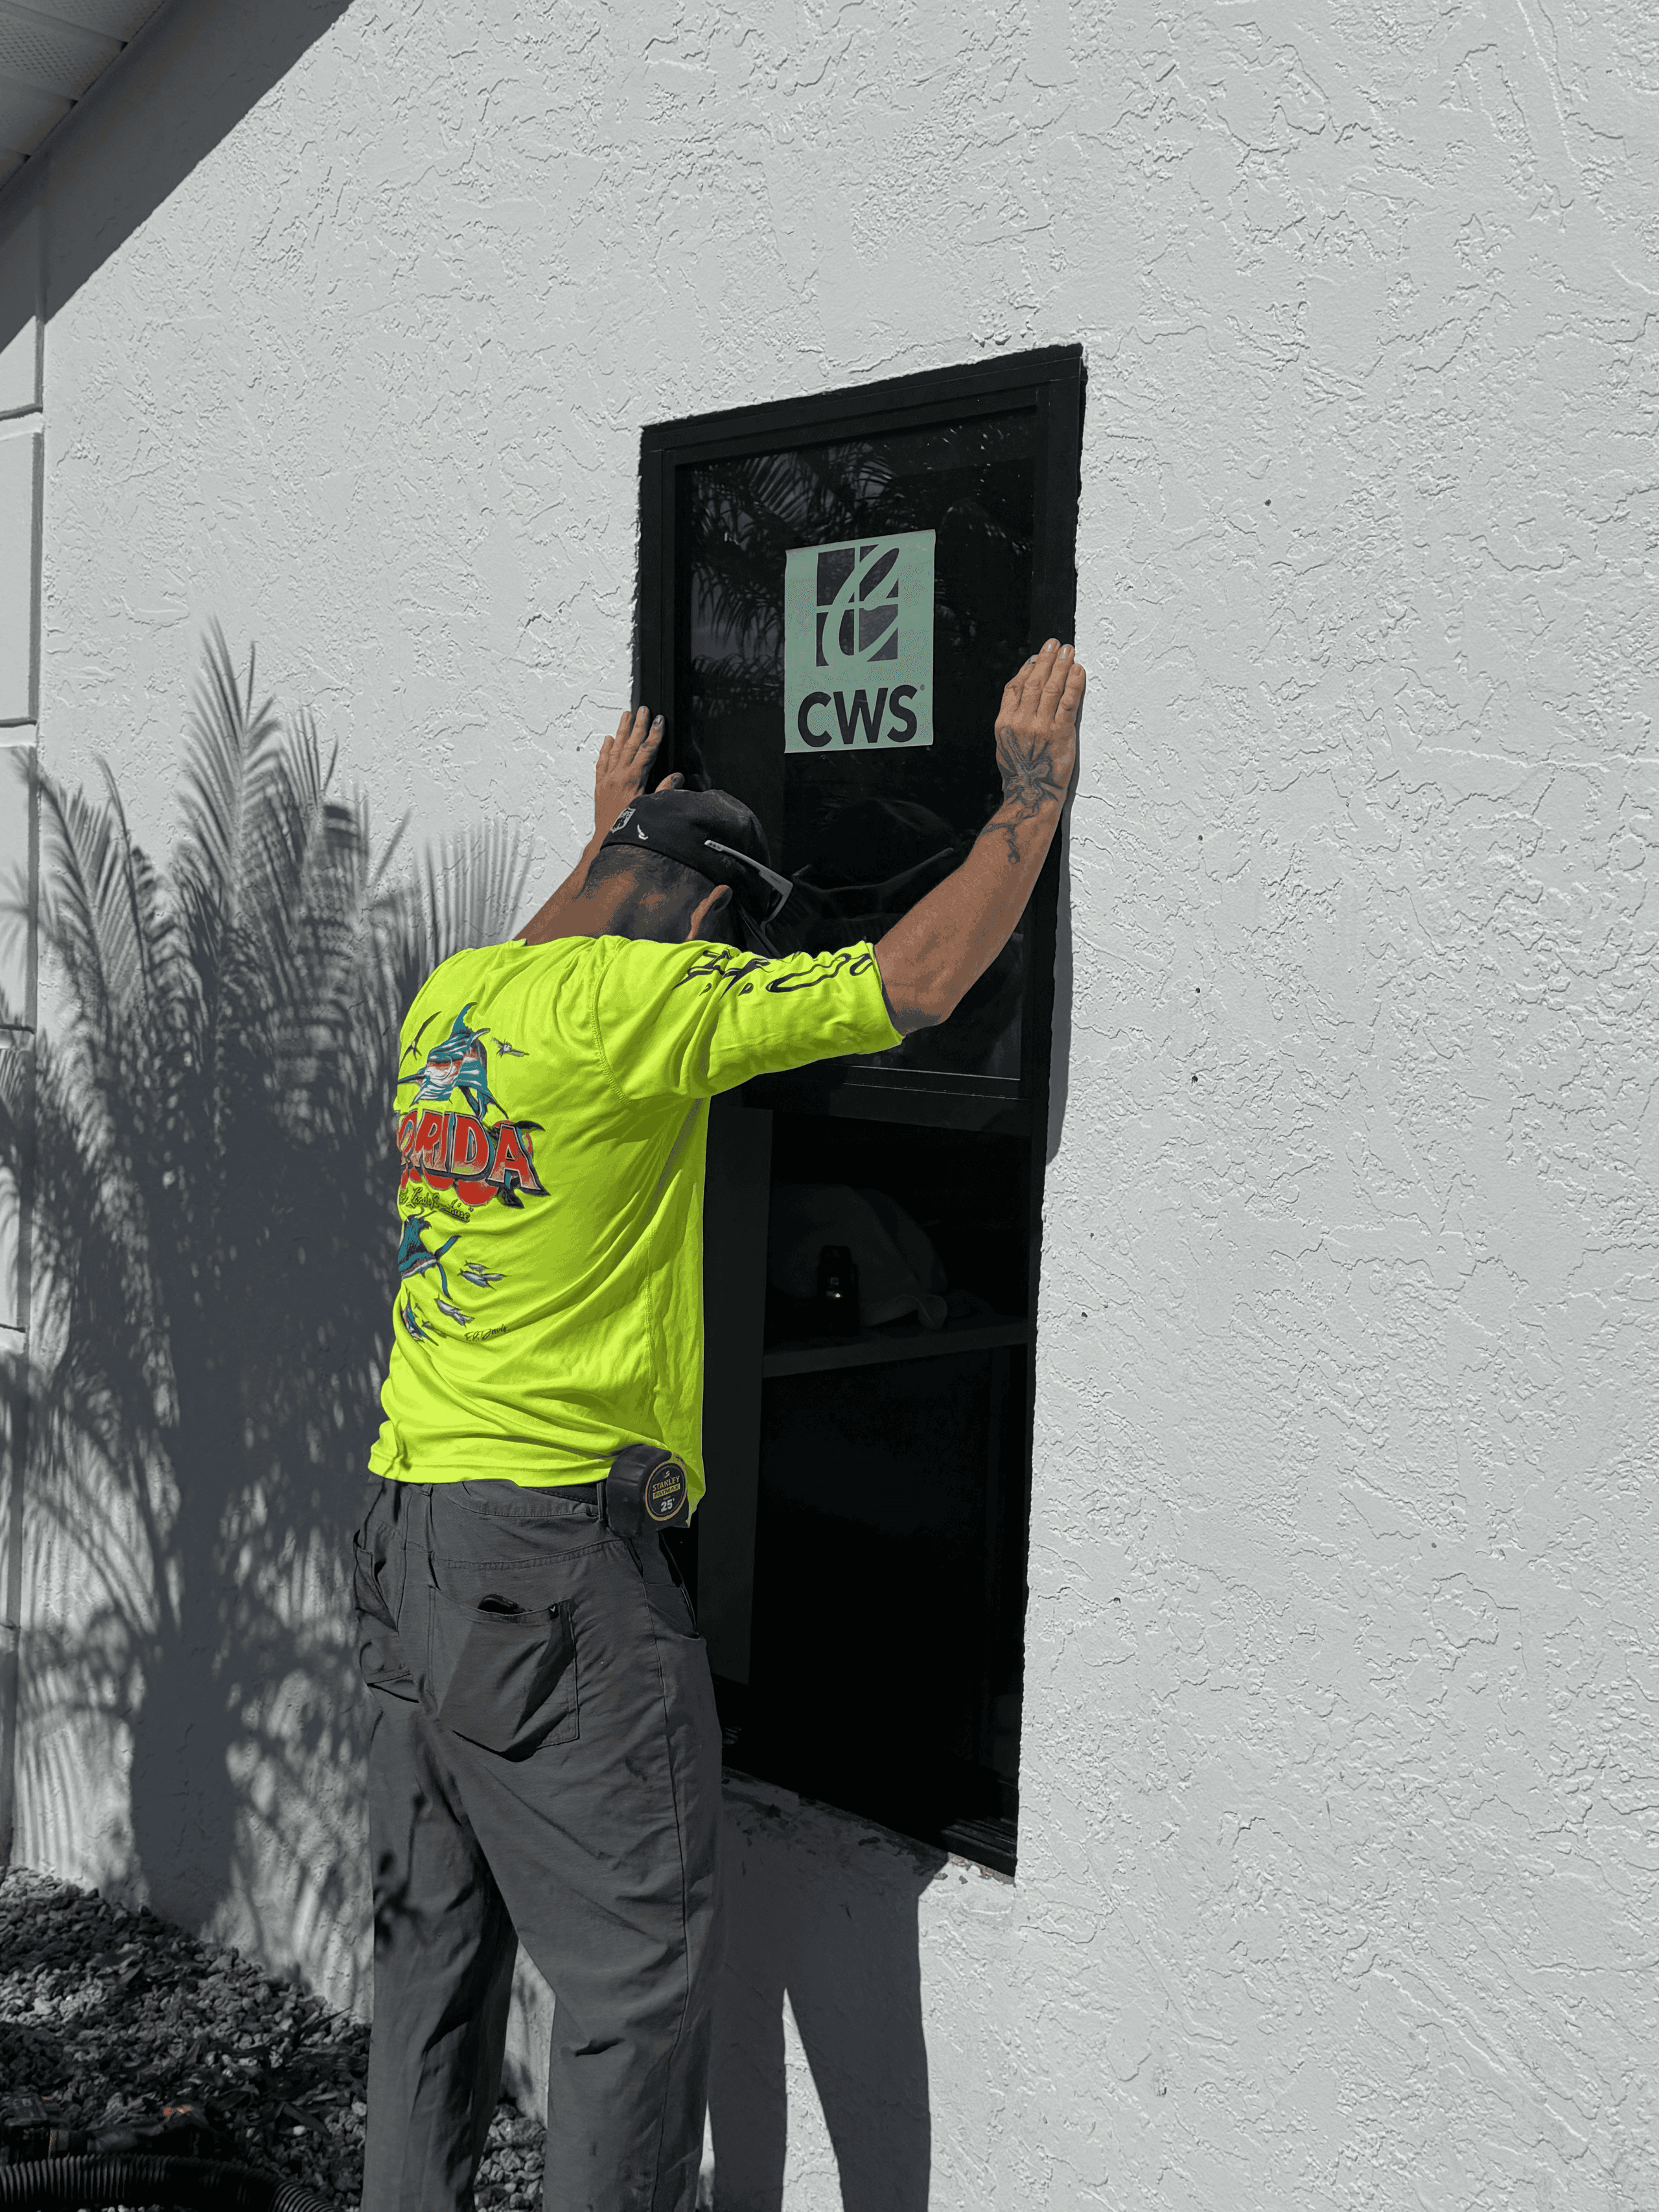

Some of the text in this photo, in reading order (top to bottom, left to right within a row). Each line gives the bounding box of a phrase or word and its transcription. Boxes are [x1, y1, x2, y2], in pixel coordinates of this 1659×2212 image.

[797, 684, 918, 747] CWS
[396, 1109, 543, 1191] ORIDA
[652, 1475, 680, 1492] STANLEY
